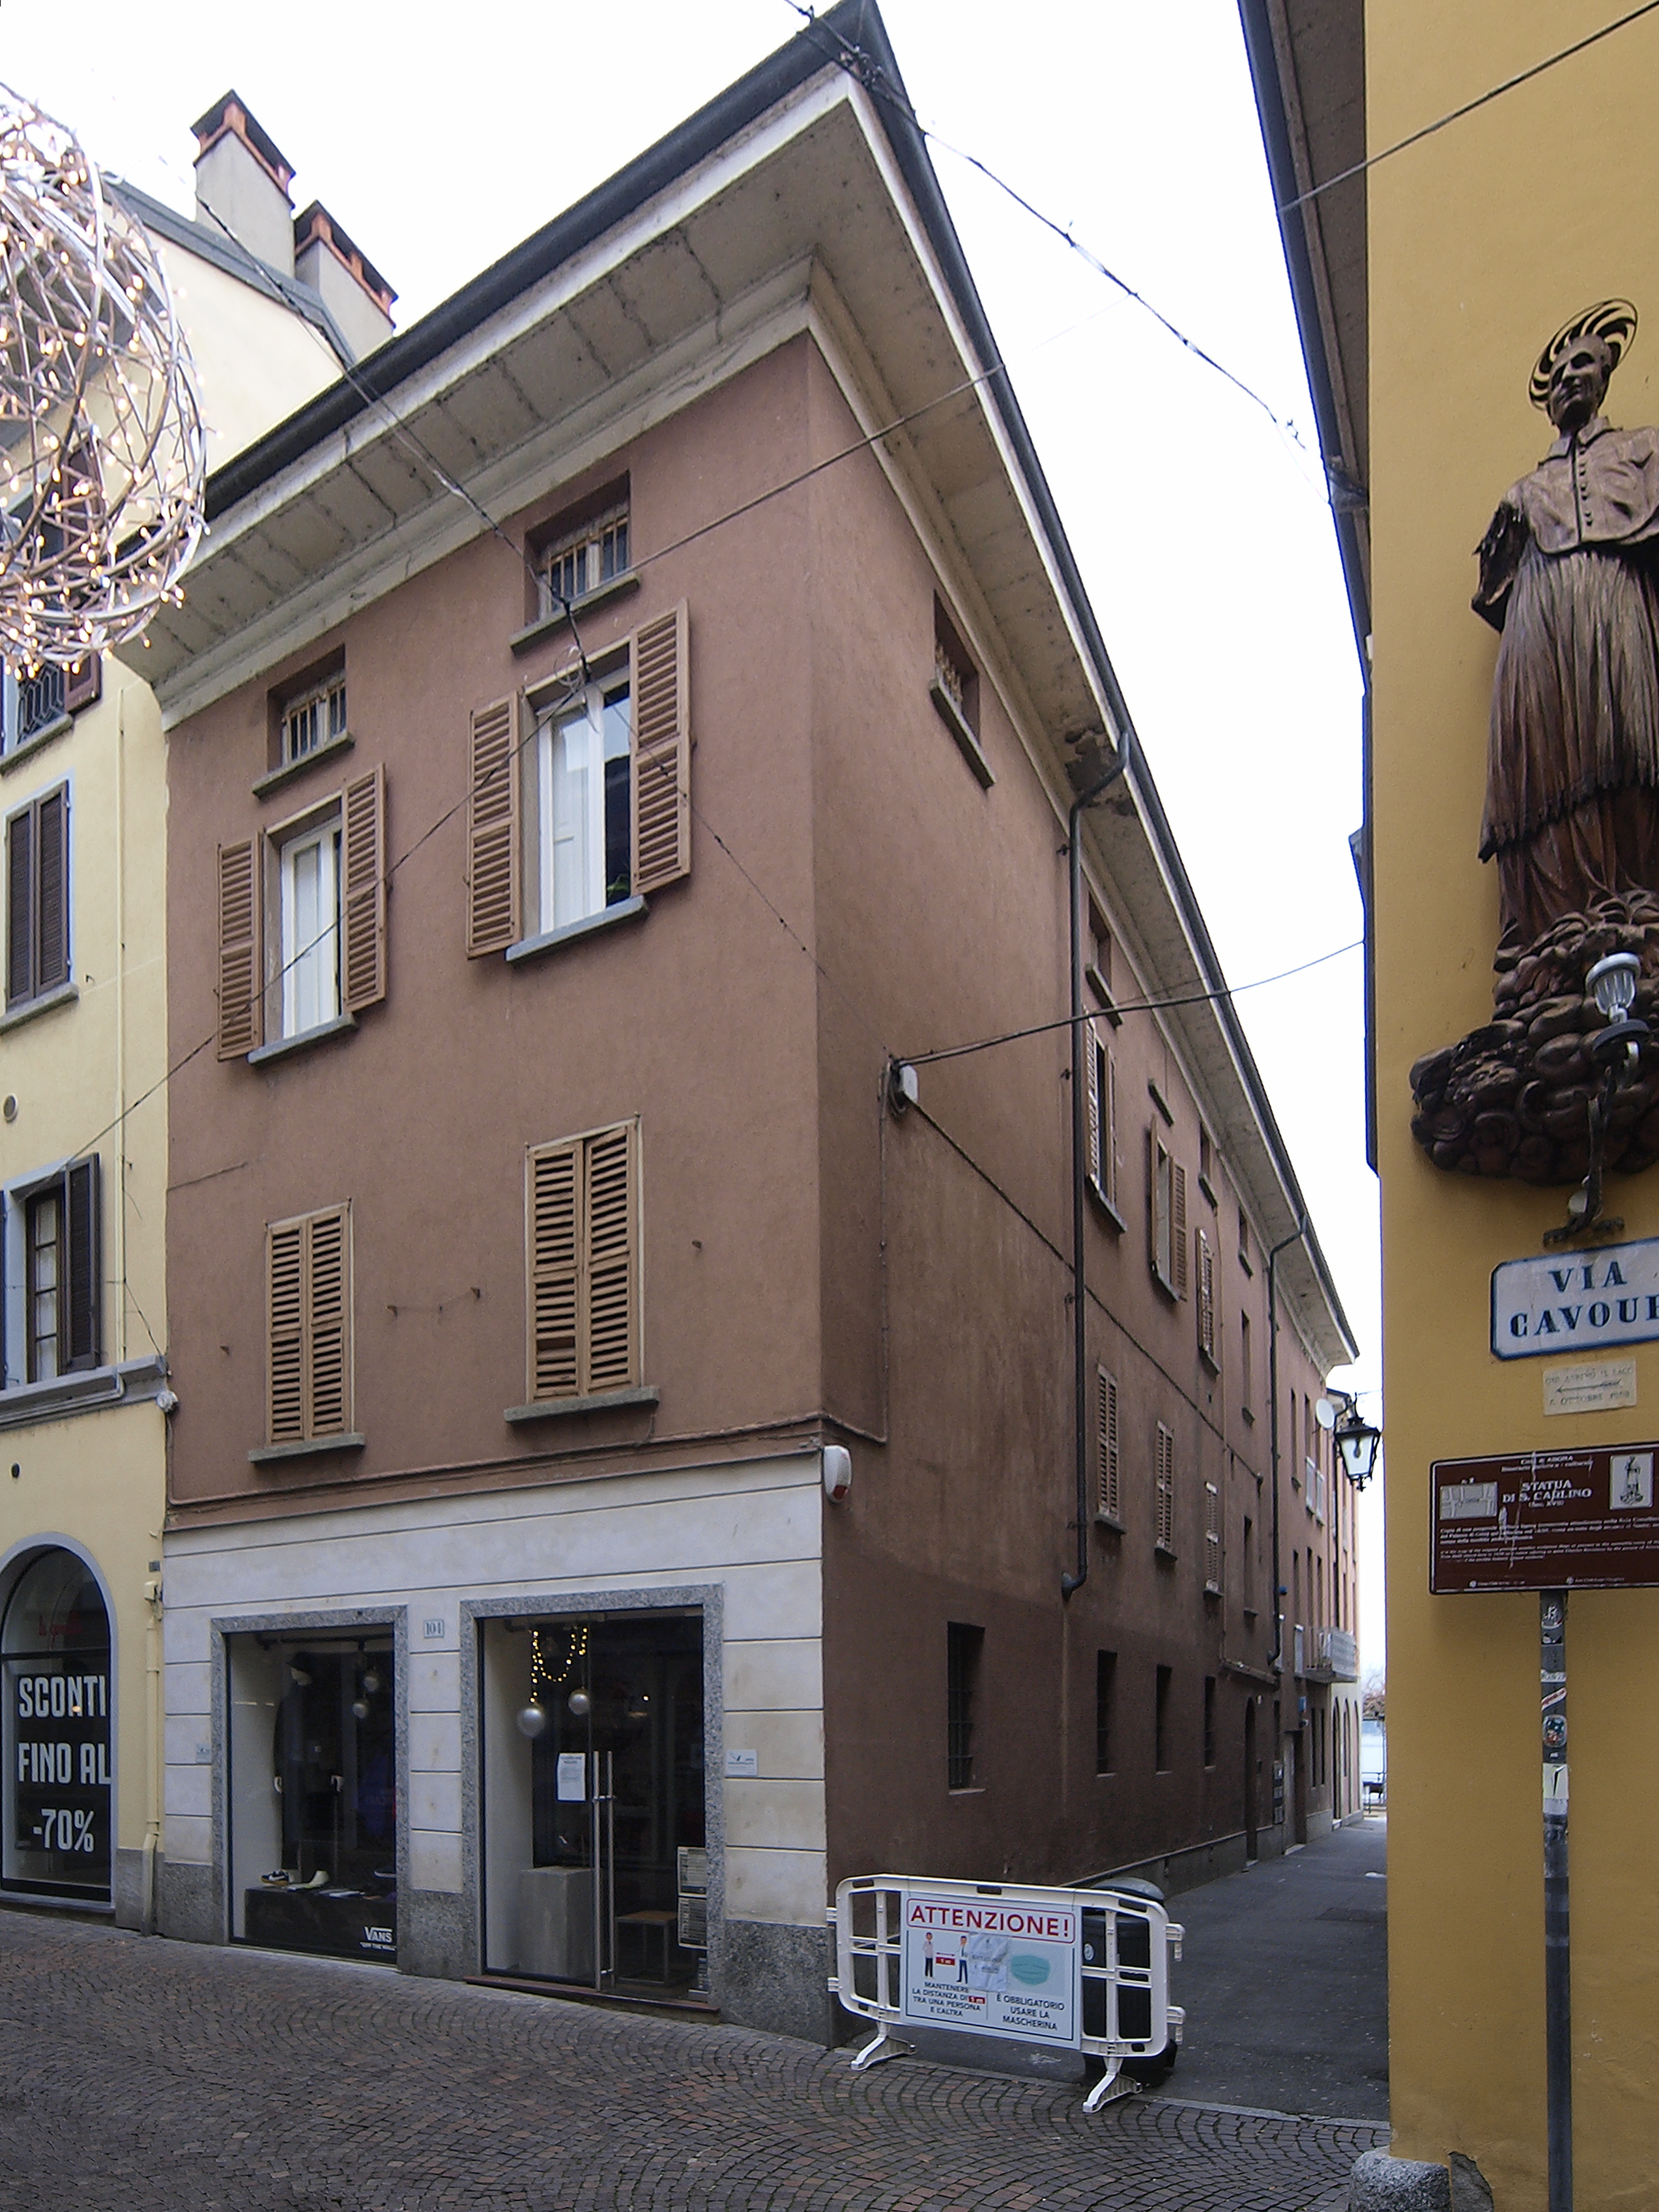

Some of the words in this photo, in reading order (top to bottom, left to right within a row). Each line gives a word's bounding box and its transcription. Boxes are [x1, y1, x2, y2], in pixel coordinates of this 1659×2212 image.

[1548, 1260, 1628, 1293] VIA
[1522, 1479, 1573, 1492] STATUA
[1503, 1492, 1516, 1504] DI
[1519, 1491, 1531, 1502] S.
[1533, 1487, 1593, 1502] CARLINO
[18, 1675, 107, 1718] SCONTI
[18, 1743, 72, 1784] FINO
[79, 1743, 111, 1784] AL
[33, 1808, 94, 1853] -70%
[910, 1905, 1069, 1938] ATTENZIONE!
[364, 1926, 393, 1943] VANS
[923, 1989, 958, 2000] DISTANZA
[924, 1981, 969, 1994] MANTENERE
[912, 1996, 927, 2004] TRA
[929, 1998, 944, 2006] UNA
[947, 2000, 981, 2011] PERSONA
[1003, 1995, 1065, 2011] OBBLIGATORIO
[1010, 2006, 1037, 2018] USARE
[1039, 2010, 1050, 2019] LA
[1002, 2015, 1058, 2031] MASCHERINA
